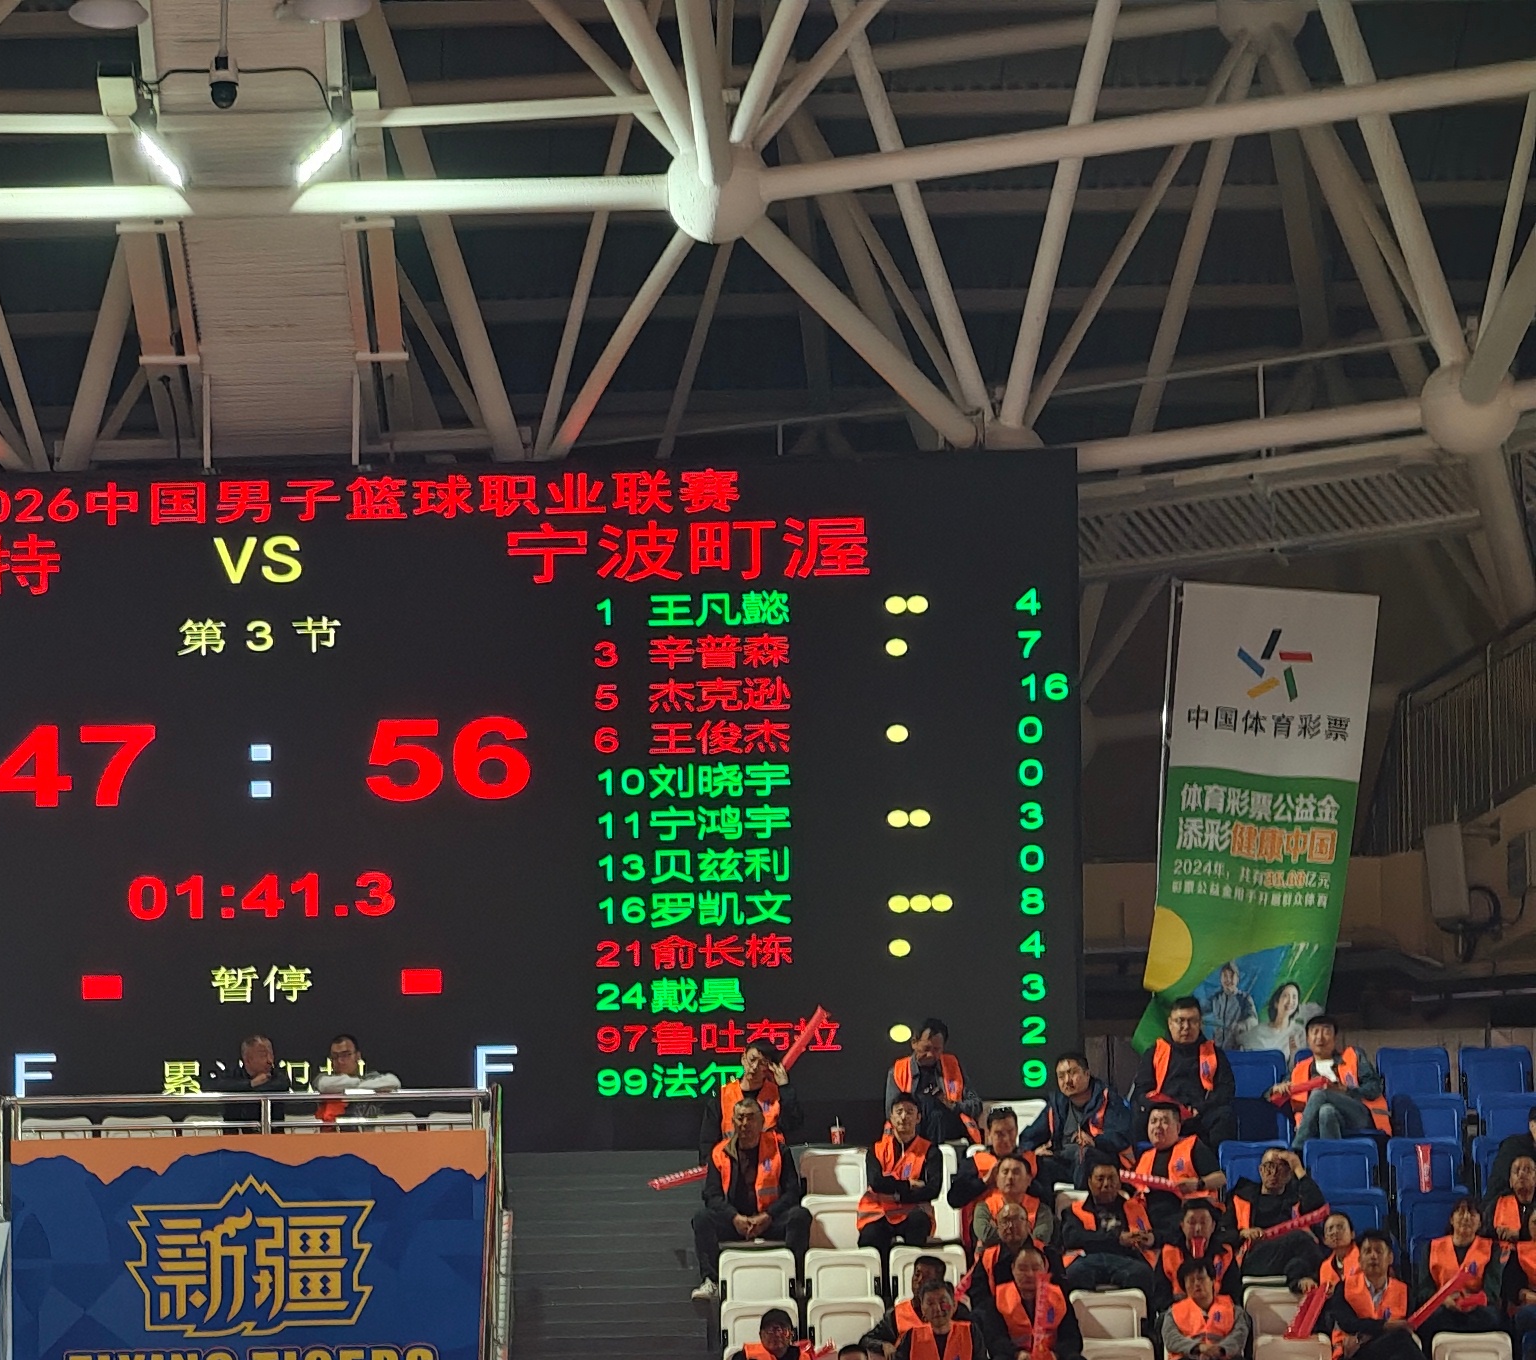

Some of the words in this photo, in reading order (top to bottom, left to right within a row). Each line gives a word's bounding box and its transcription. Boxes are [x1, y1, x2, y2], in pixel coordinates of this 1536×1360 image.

[213, 535, 303, 585] VS
[506, 516, 871, 584] 宁波町渥
[597, 598, 611, 625] 1
[1016, 588, 1041, 616] 4
[177, 616, 227, 657] 第
[246, 620, 274, 652] 3
[291, 616, 341, 653] 节
[594, 641, 618, 667] 3
[649, 633, 789, 670] 辛普森
[1018, 630, 1041, 658] 7
[595, 684, 618, 710] 5
[649, 676, 791, 713] 杰克逊
[1022, 673, 1068, 701] 16
[594, 727, 619, 753] 6
[649, 719, 790, 755] 王俊杰
[1018, 716, 1042, 744] 0
[1186, 703, 1351, 742] 中国体育彩票
[366, 715, 531, 803] 56
[1019, 759, 1043, 786] 0
[1020, 802, 1043, 830] 3
[1180, 782, 1341, 825] 体育彩票公益金
[1020, 845, 1044, 872] 0
[1175, 816, 1339, 864] 添彩健康中国
[127, 871, 396, 921] 01:41.3
[1021, 888, 1044, 915] 8
[1020, 931, 1045, 958] 4
[210, 965, 312, 1003] 暂停
[1022, 974, 1046, 1001] 3
[1022, 1016, 1046, 1044] 2
[13, 1052, 57, 1098] F
[475, 1044, 518, 1090] F
[1023, 1060, 1047, 1087] 9
[154, 1206, 348, 1321] 新疆
